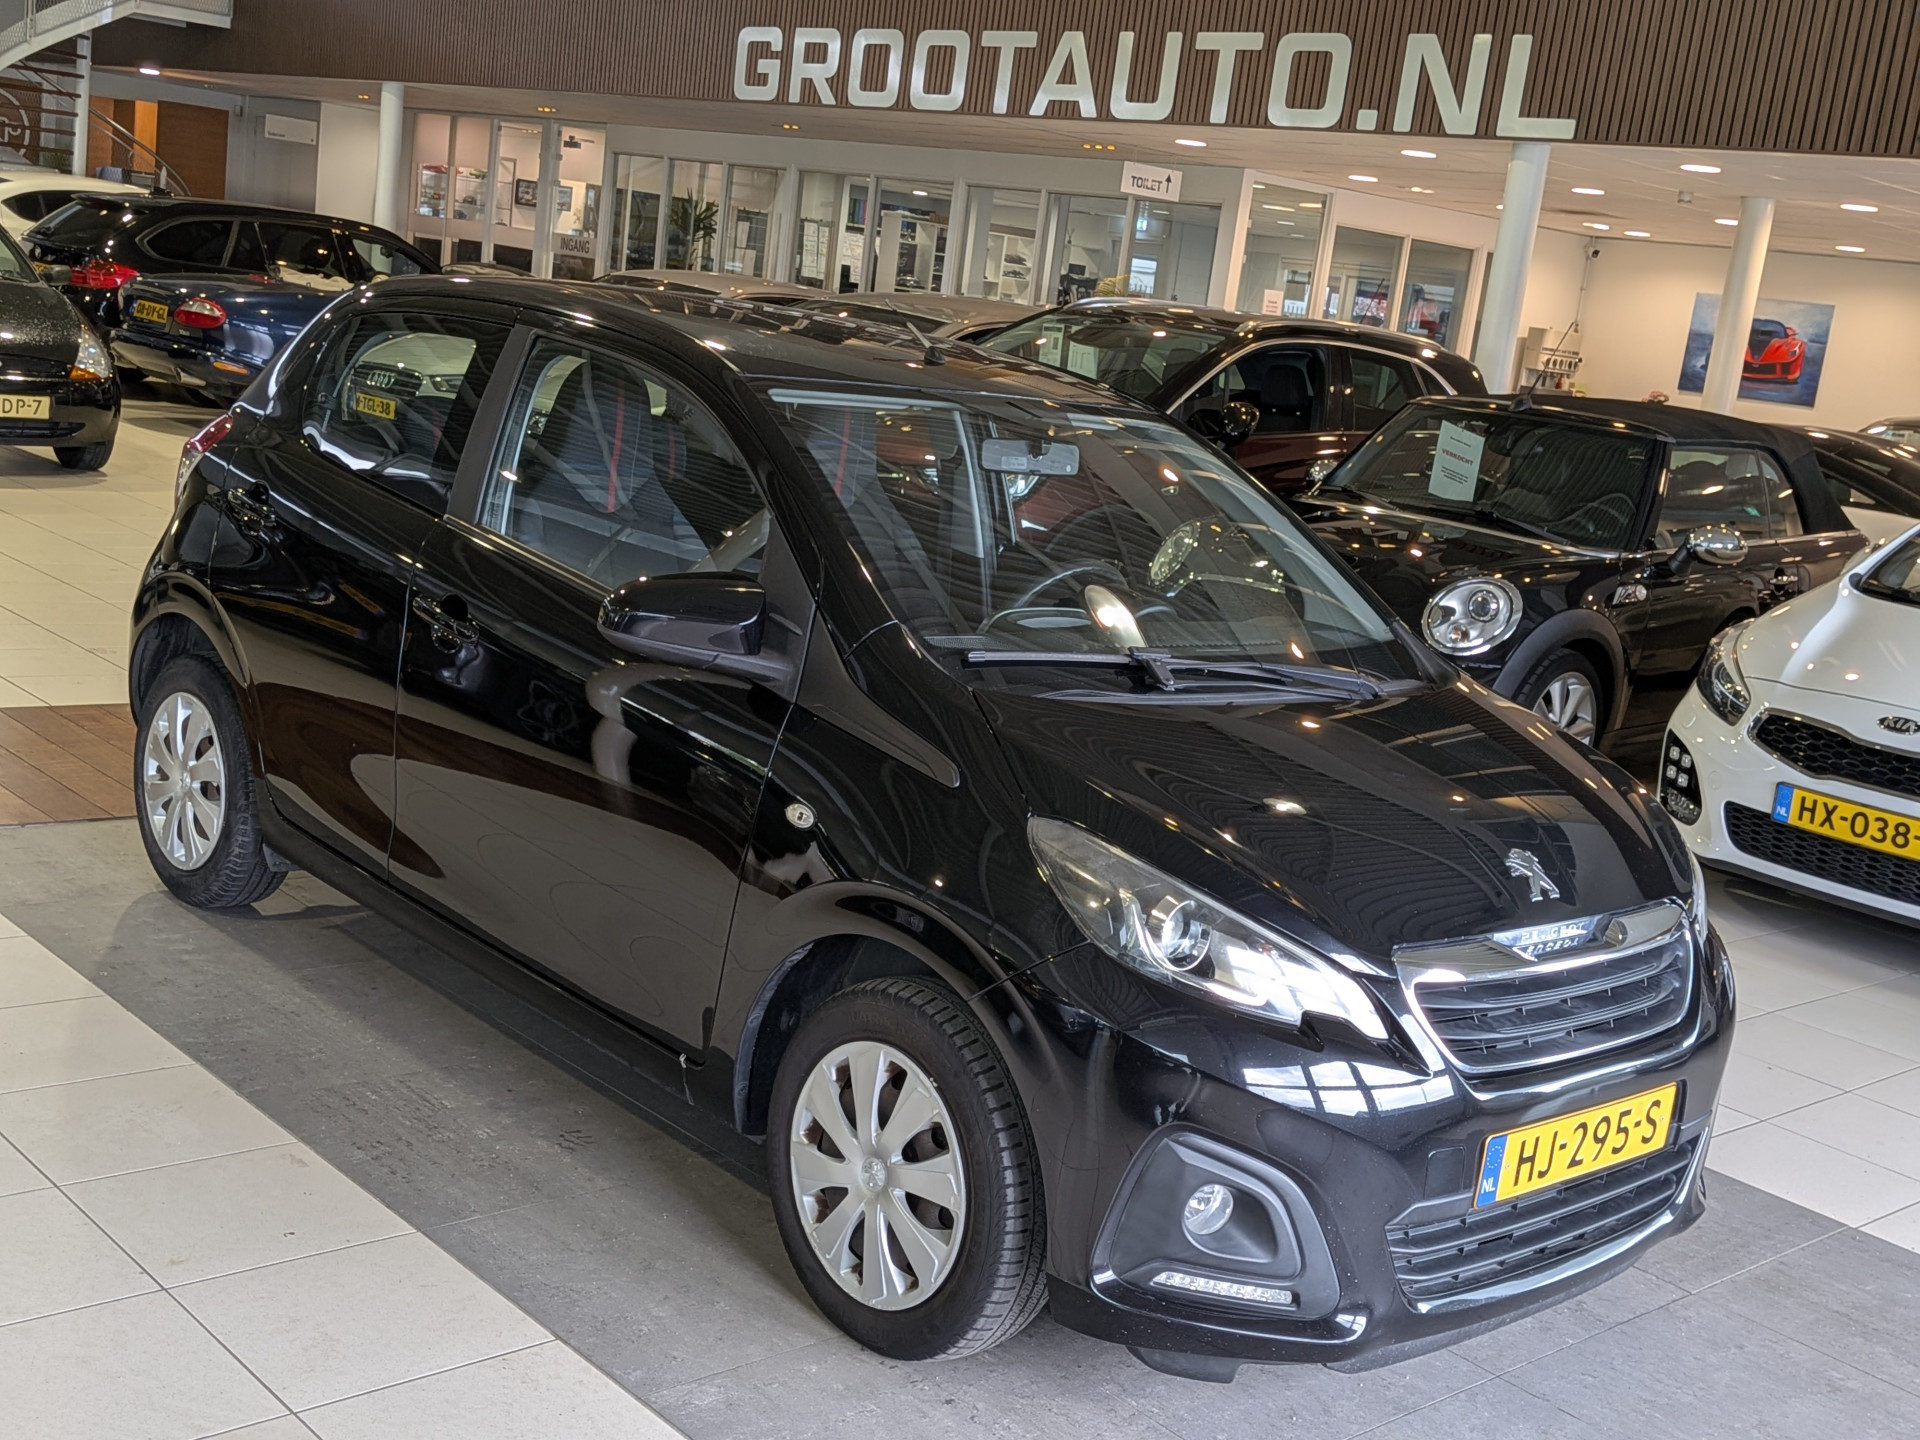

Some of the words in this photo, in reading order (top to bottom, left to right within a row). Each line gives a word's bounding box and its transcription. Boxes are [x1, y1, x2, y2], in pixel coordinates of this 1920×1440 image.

[733, 26, 1577, 140] GROOTAUTO.NL
[1131, 175, 1163, 192] TOILET
[560, 237, 590, 254] INGANG
[2, 398, 43, 415] DP-7
[1442, 448, 1474, 466] VERKOCHT
[1884, 717, 1918, 734] KIA
[1775, 805, 1788, 817] NL
[1513, 1099, 1662, 1187] HJ-295-S
[1481, 1177, 1496, 1194] NL
